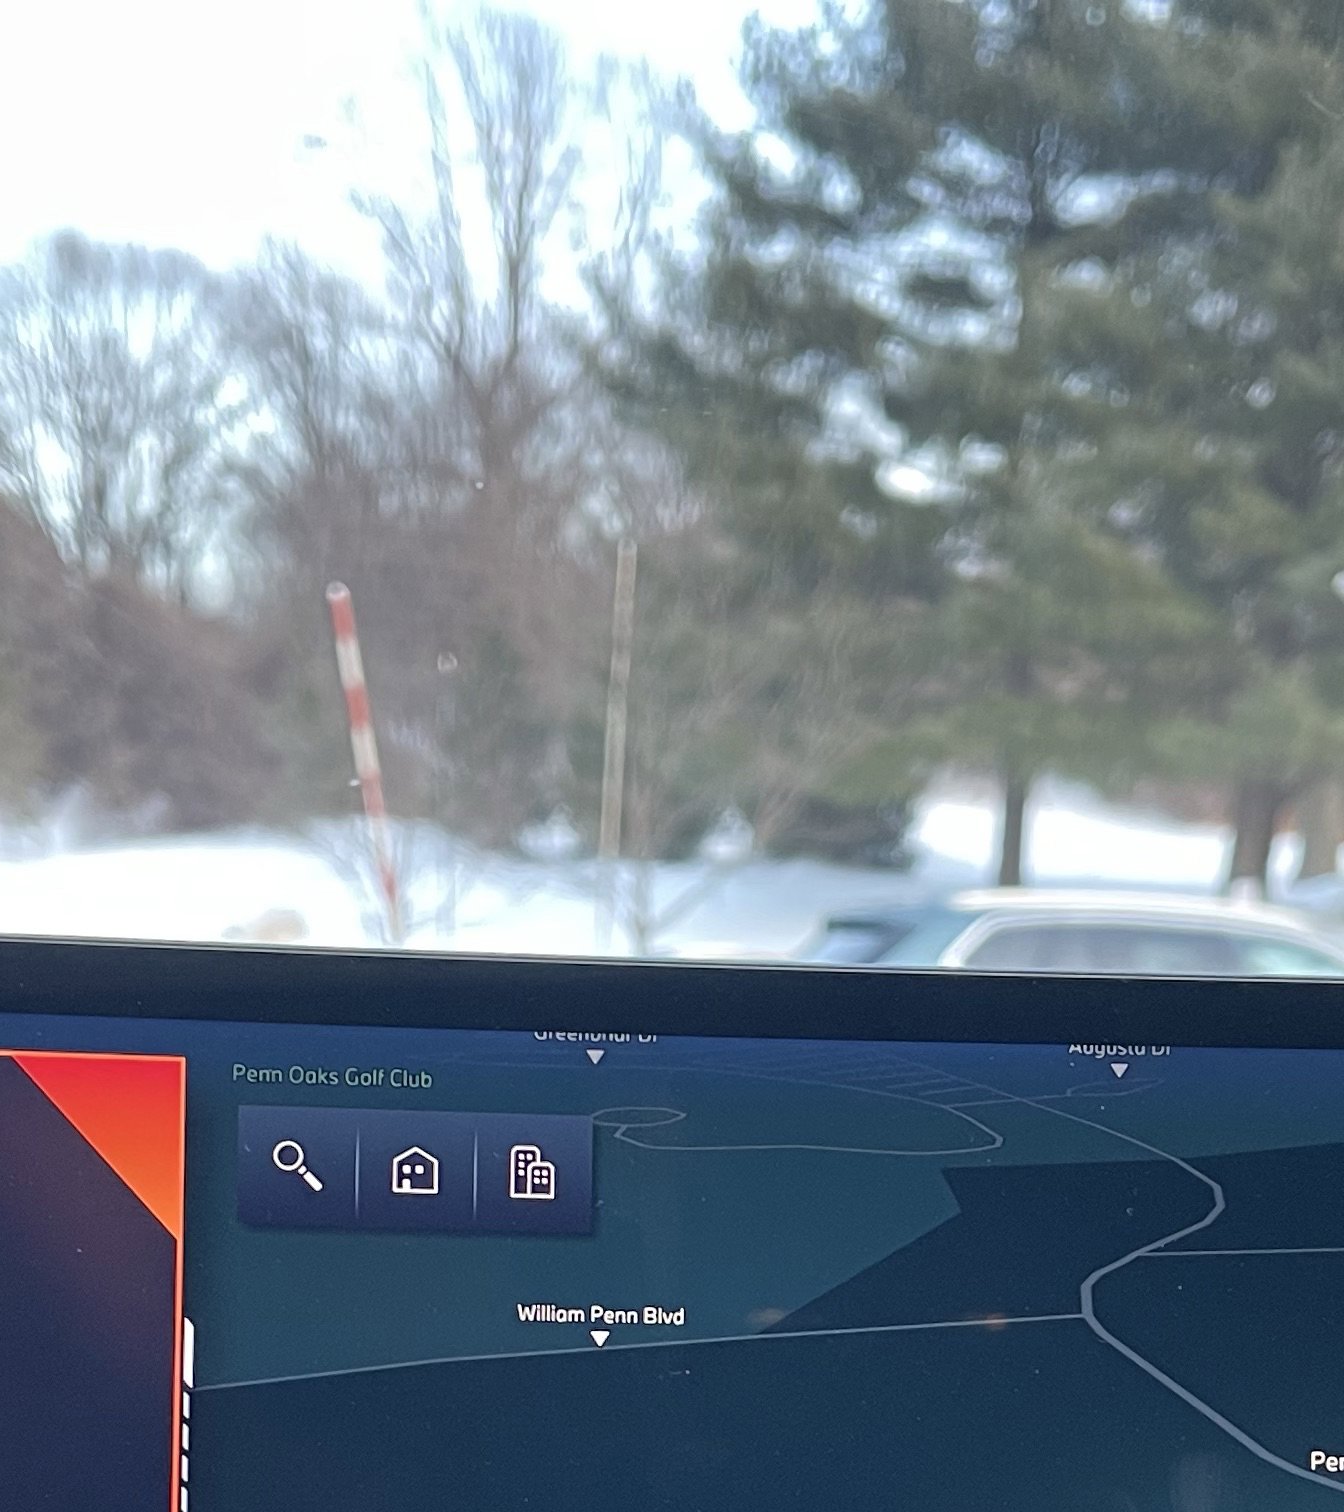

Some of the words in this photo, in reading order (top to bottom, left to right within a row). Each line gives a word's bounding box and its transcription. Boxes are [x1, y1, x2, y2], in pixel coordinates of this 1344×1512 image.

[232, 1063, 283, 1083] Penn
[289, 1065, 339, 1085] Oaks
[345, 1067, 384, 1086] Golf
[390, 1068, 432, 1088] Club
[517, 1303, 586, 1323] William
[590, 1305, 639, 1325] Penn
[643, 1306, 685, 1326] Blvd
